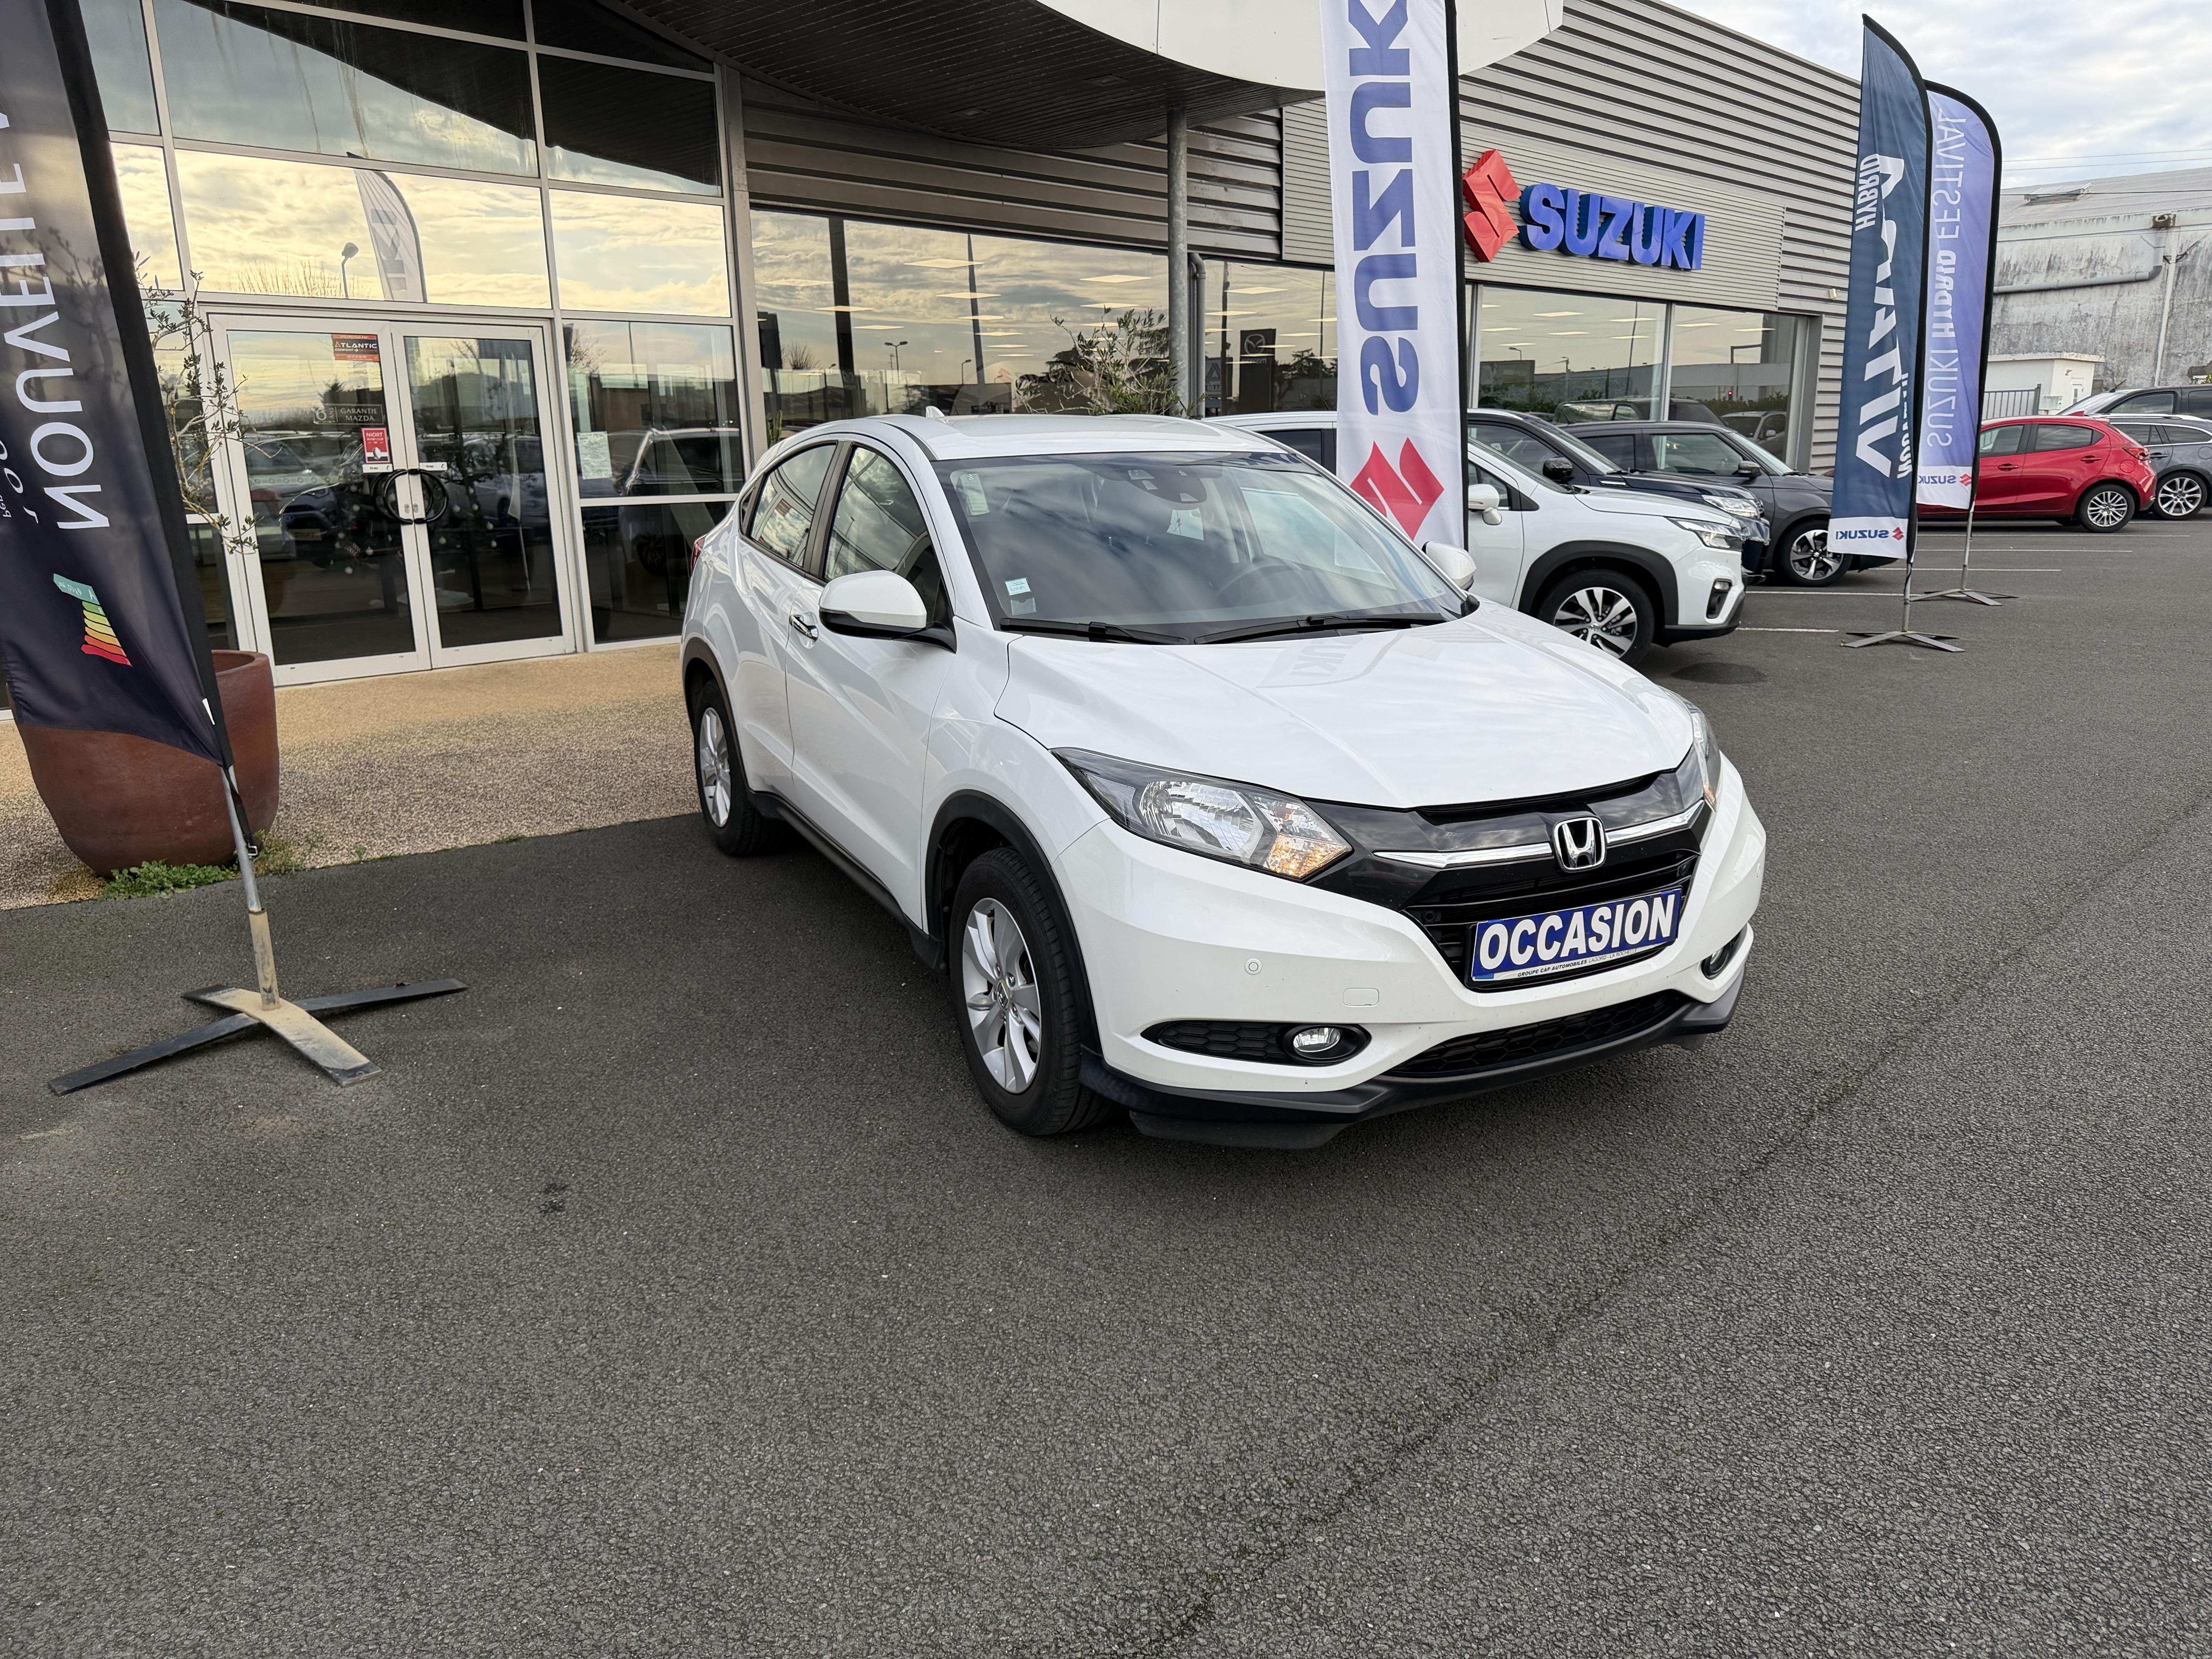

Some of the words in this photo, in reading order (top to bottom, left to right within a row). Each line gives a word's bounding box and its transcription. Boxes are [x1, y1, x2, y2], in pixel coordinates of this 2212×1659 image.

[1520, 183, 1705, 270] SUZUKI
[1479, 894, 1675, 970] OCCASION
[1551, 960, 1587, 970] AUTOMOBILES
